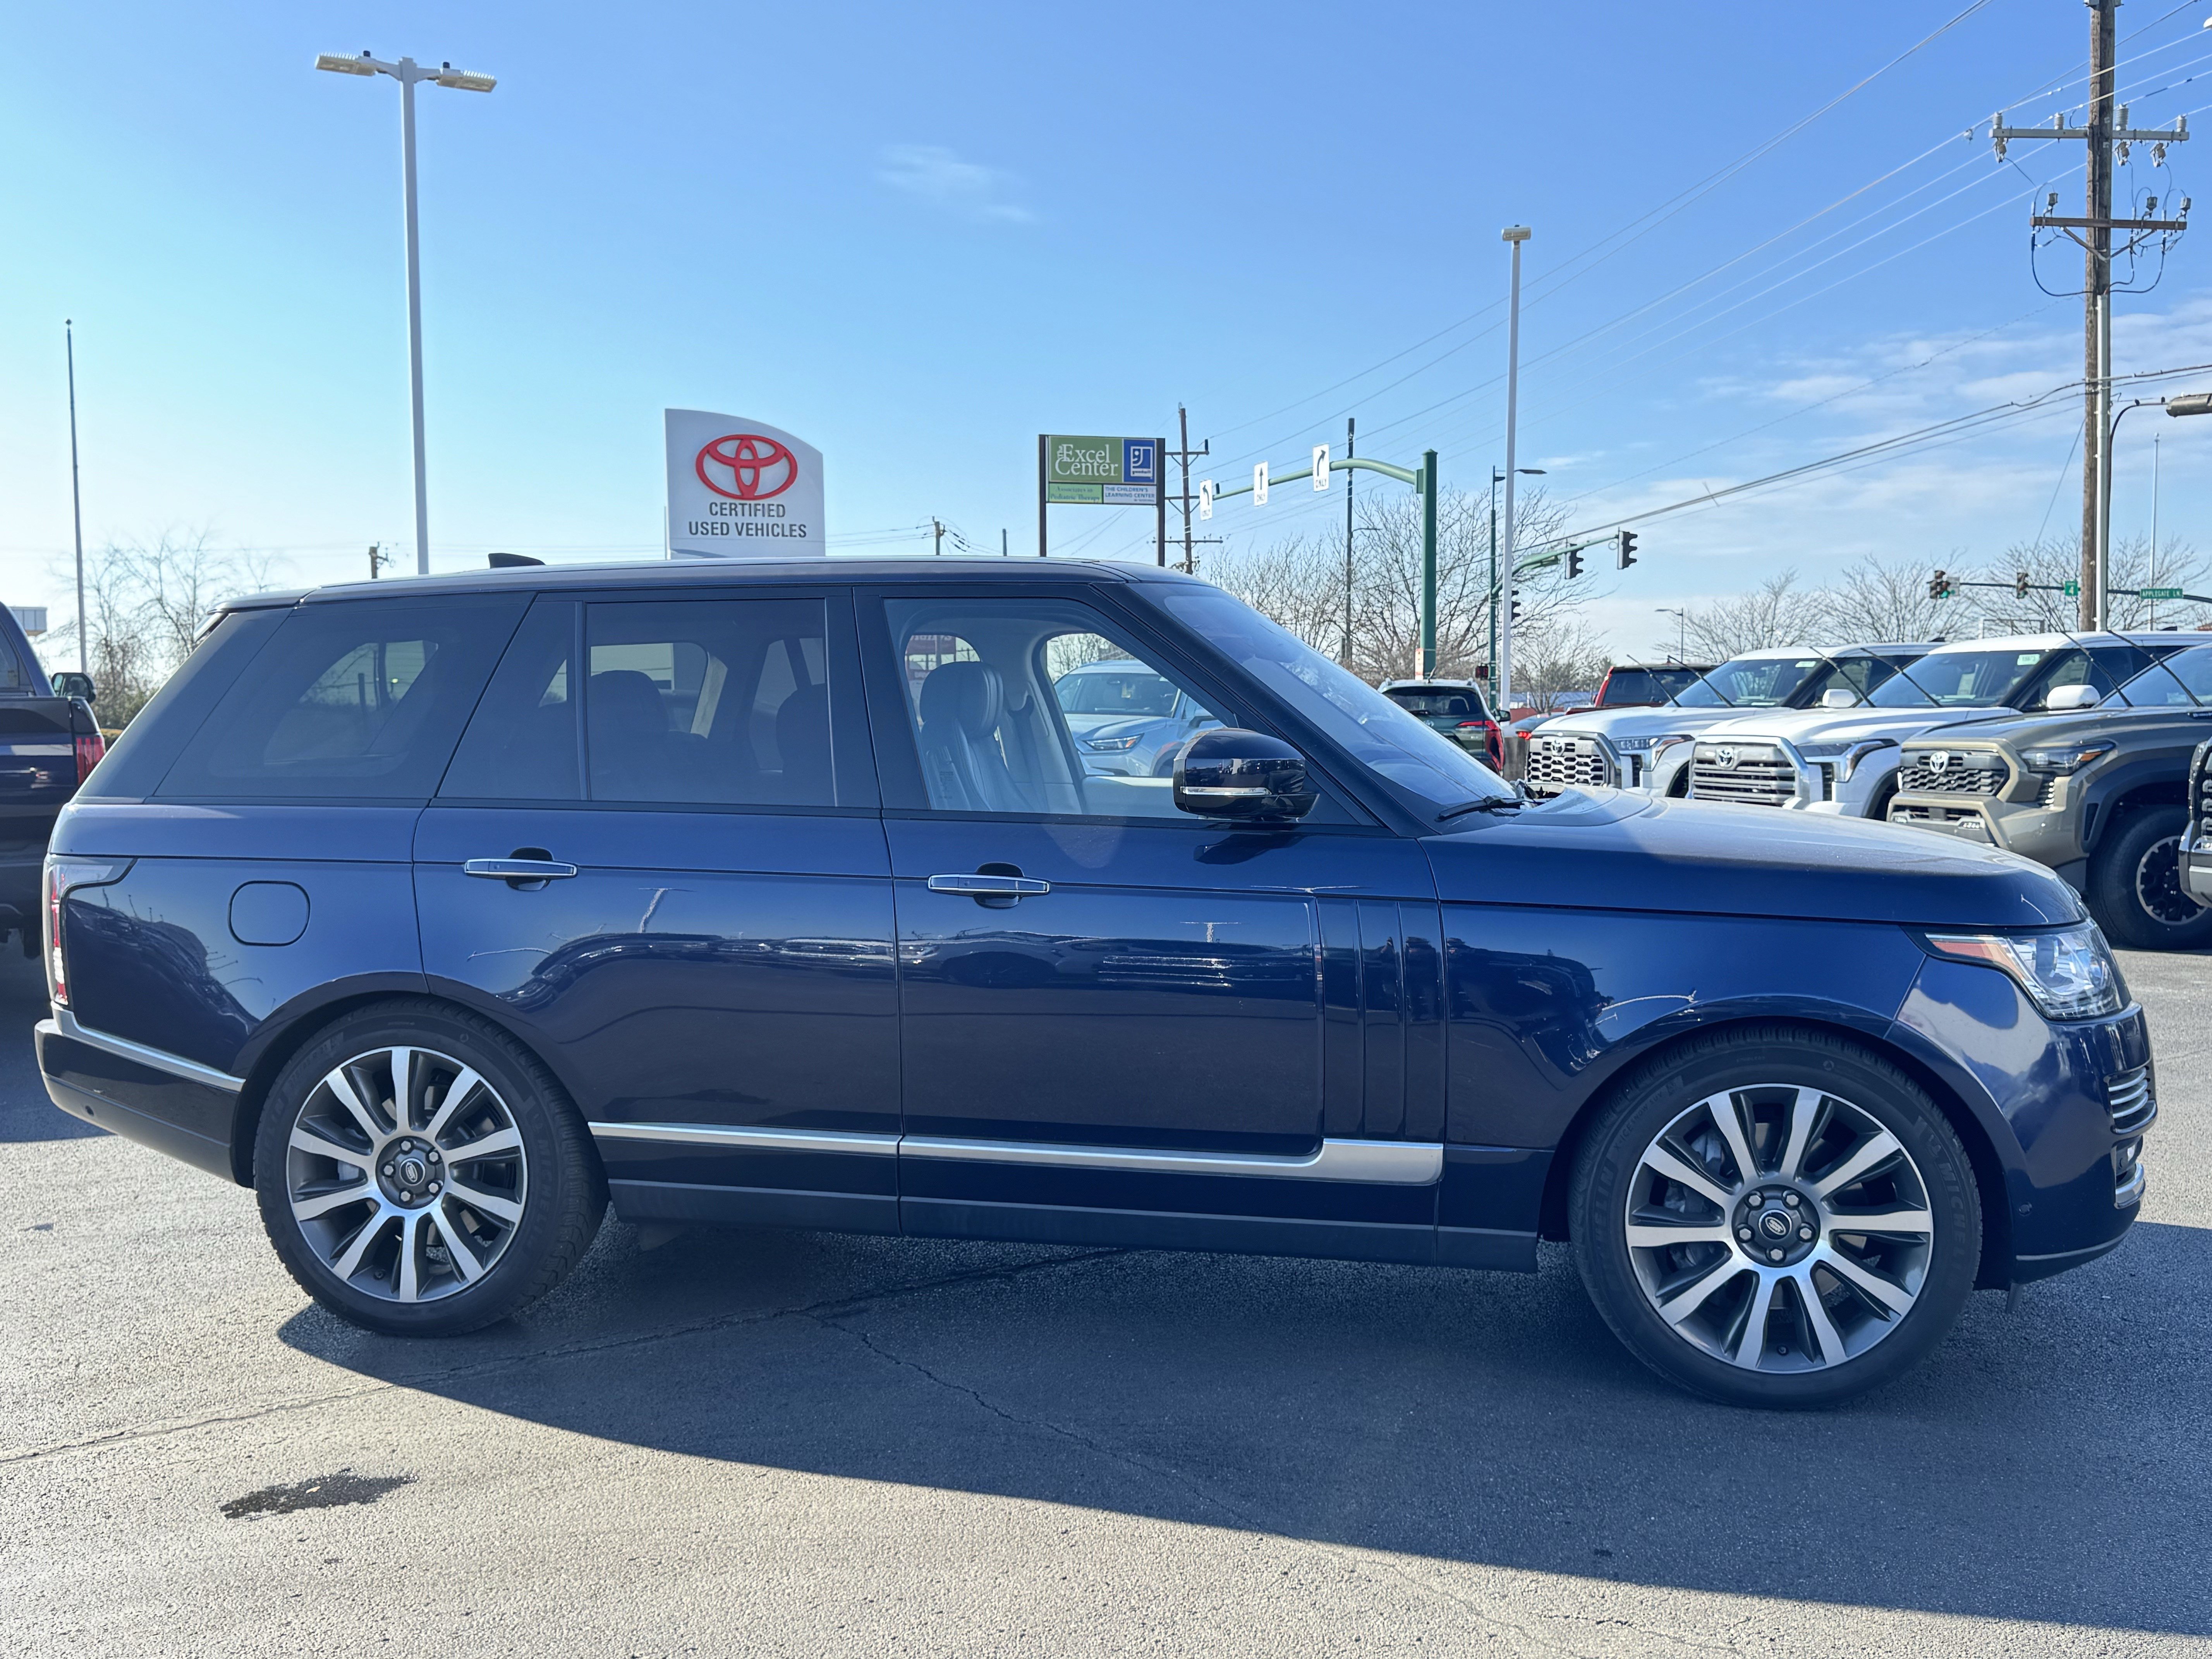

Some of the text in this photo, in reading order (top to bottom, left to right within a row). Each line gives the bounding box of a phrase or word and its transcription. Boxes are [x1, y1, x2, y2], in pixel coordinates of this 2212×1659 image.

[1060, 444, 1111, 463] Excel
[1055, 457, 1118, 476] Center
[709, 502, 786, 518] CERTIFIED
[689, 521, 807, 538] USED VEHICLES
[2069, 586, 2074, 595] 4
